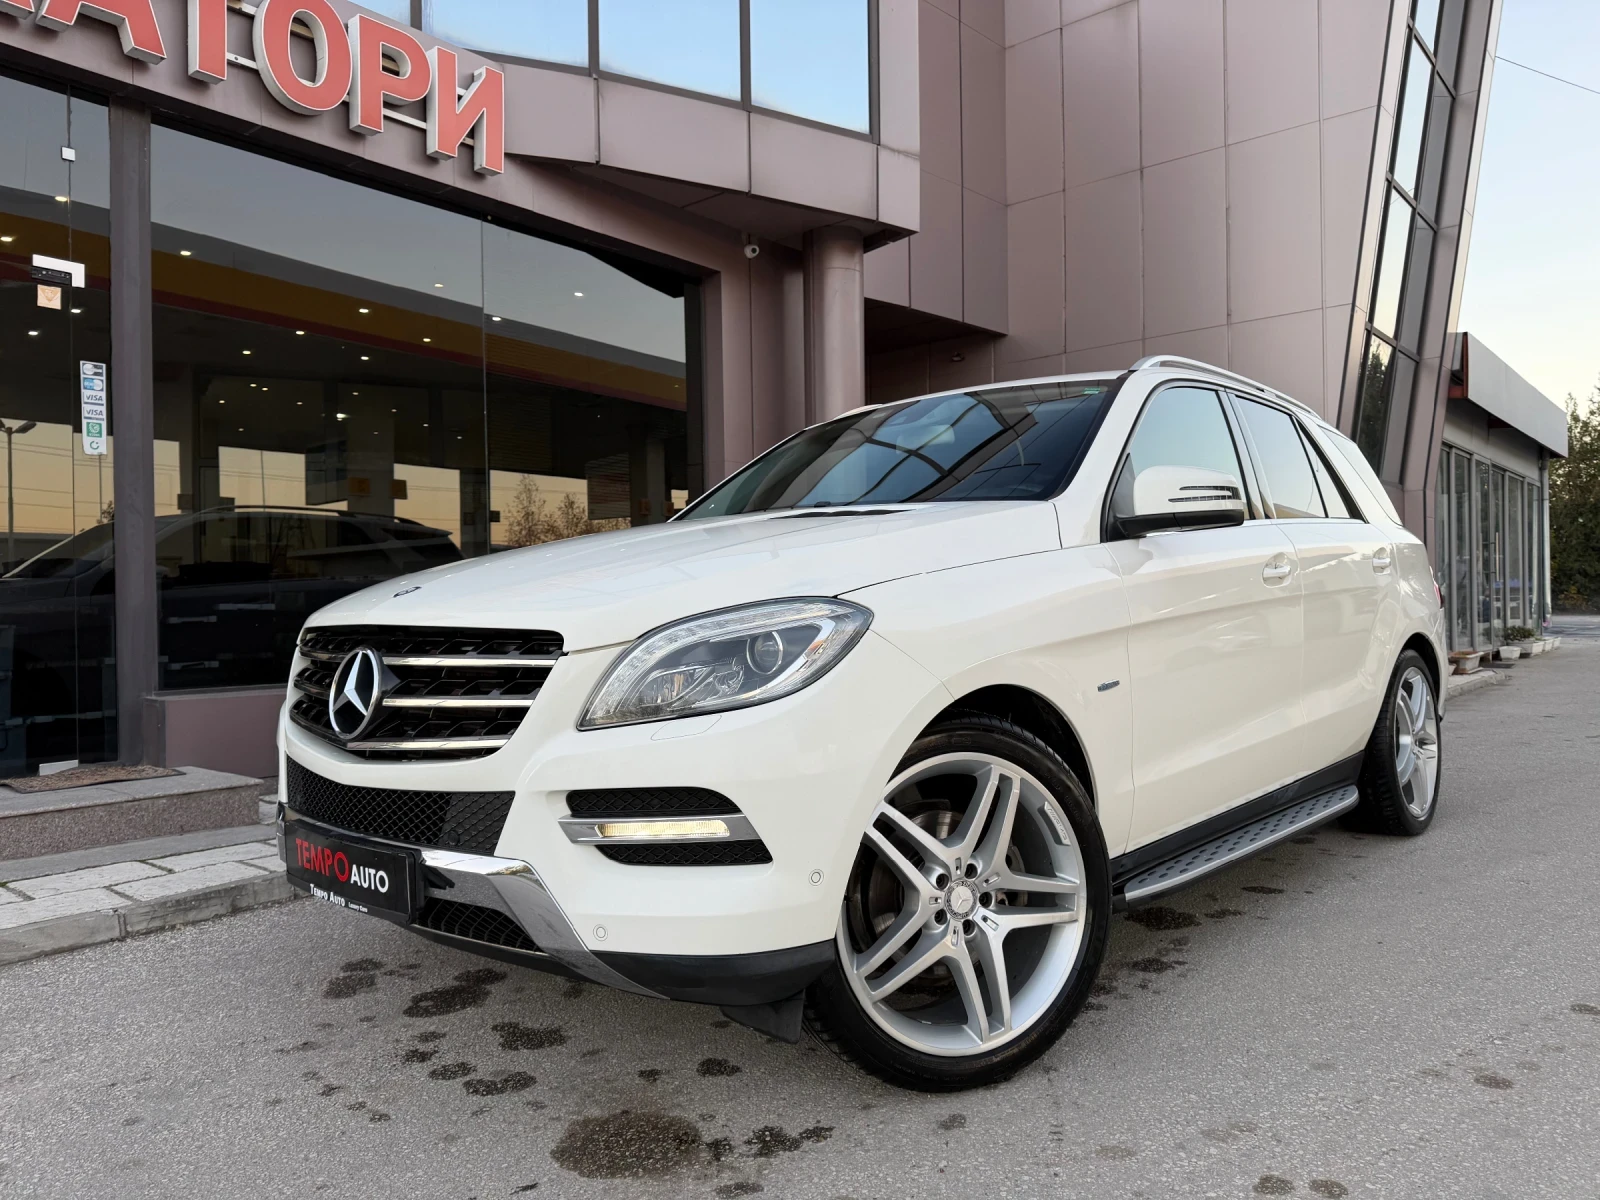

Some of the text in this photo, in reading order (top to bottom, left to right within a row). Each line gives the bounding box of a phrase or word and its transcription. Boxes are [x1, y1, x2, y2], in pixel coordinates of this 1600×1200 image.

[85, 394, 103, 402] VISA
[86, 408, 104, 417] VISA
[295, 837, 389, 893] TEMPO AUTO
